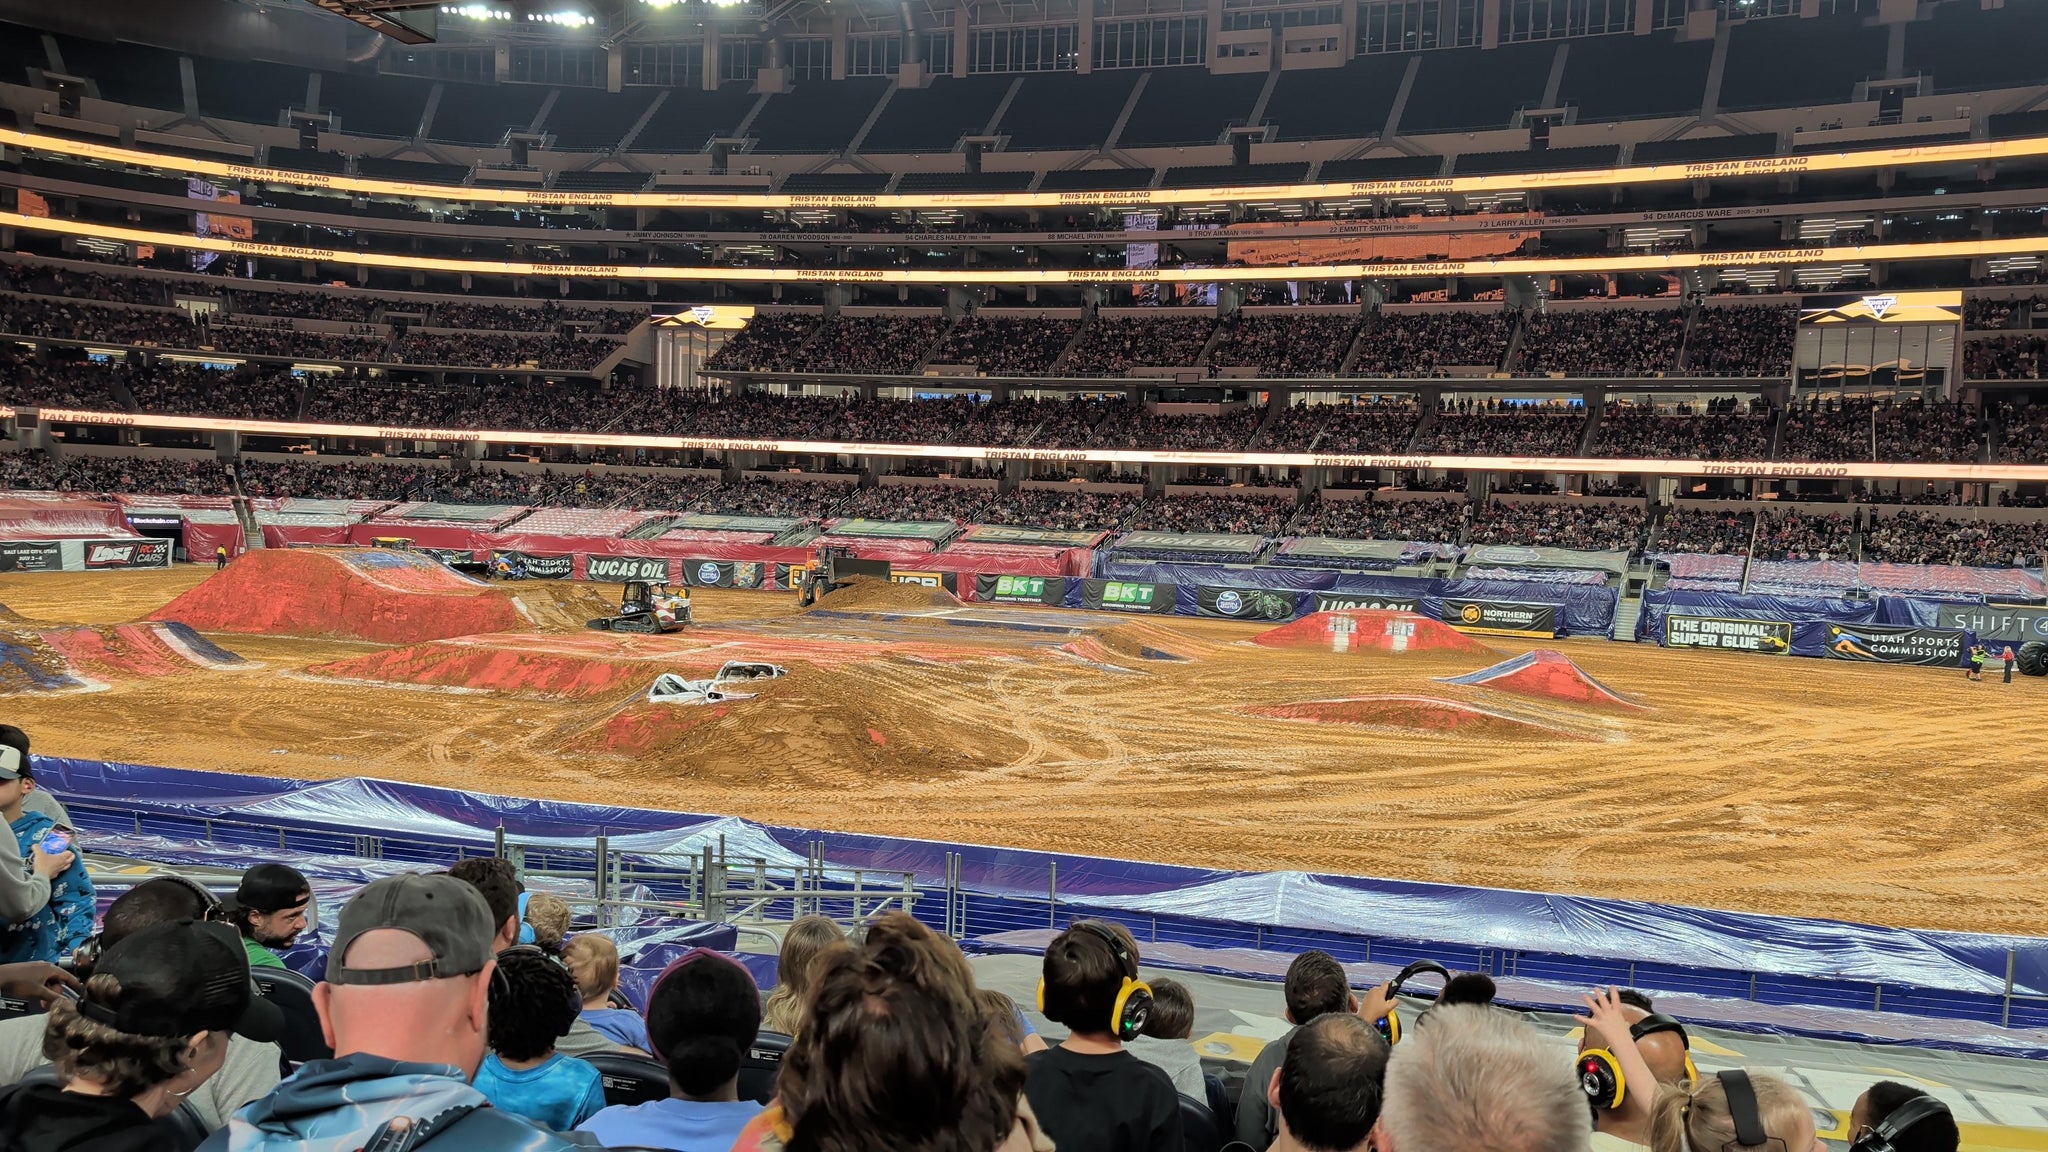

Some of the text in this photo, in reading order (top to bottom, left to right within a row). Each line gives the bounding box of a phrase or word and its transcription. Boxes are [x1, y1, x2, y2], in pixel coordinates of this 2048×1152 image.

[1685, 157, 1808, 172] TRISTAN ENGLAND
[227, 165, 330, 183] TRISTAN ENGLAND
[1400, 180, 1453, 188] ENGLAND
[1706, 209, 1732, 217] WARE
[230, 242, 278, 252] TRISTAN
[281, 246, 334, 257] ENGLAND
[1700, 250, 1824, 261] TRISTAN ENGLAND
[574, 265, 618, 273] ENGLAND
[1411, 263, 1465, 271] ENGLAND
[72, 414, 135, 424] ENGLAND
[378, 430, 427, 439] TRISTAN
[681, 441, 778, 451] TRISTAN ENGLAND
[984, 451, 1087, 461] TRISTAN ENGLAND
[1314, 458, 1432, 468] TRISTAN ENGLAND
[1702, 465, 1848, 476] TRISTAN ENGLAND
[139, 545, 154, 553] RC
[136, 554, 163, 563] CARS
[525, 565, 571, 573] OMMISSION
[589, 560, 666, 578] LUCAS OIL
[998, 579, 1044, 594] BKT
[1103, 585, 1153, 600] BKT
[1483, 609, 1533, 619] NORTHERN
[1671, 619, 1768, 636] THE ORIGINAL
[1954, 614, 2030, 632] SHIFT
[1671, 631, 1760, 649] SUPER GLUE
[1871, 634, 1960, 647] UTAH SPORTS
[1870, 644, 1958, 657] COMMISSION
